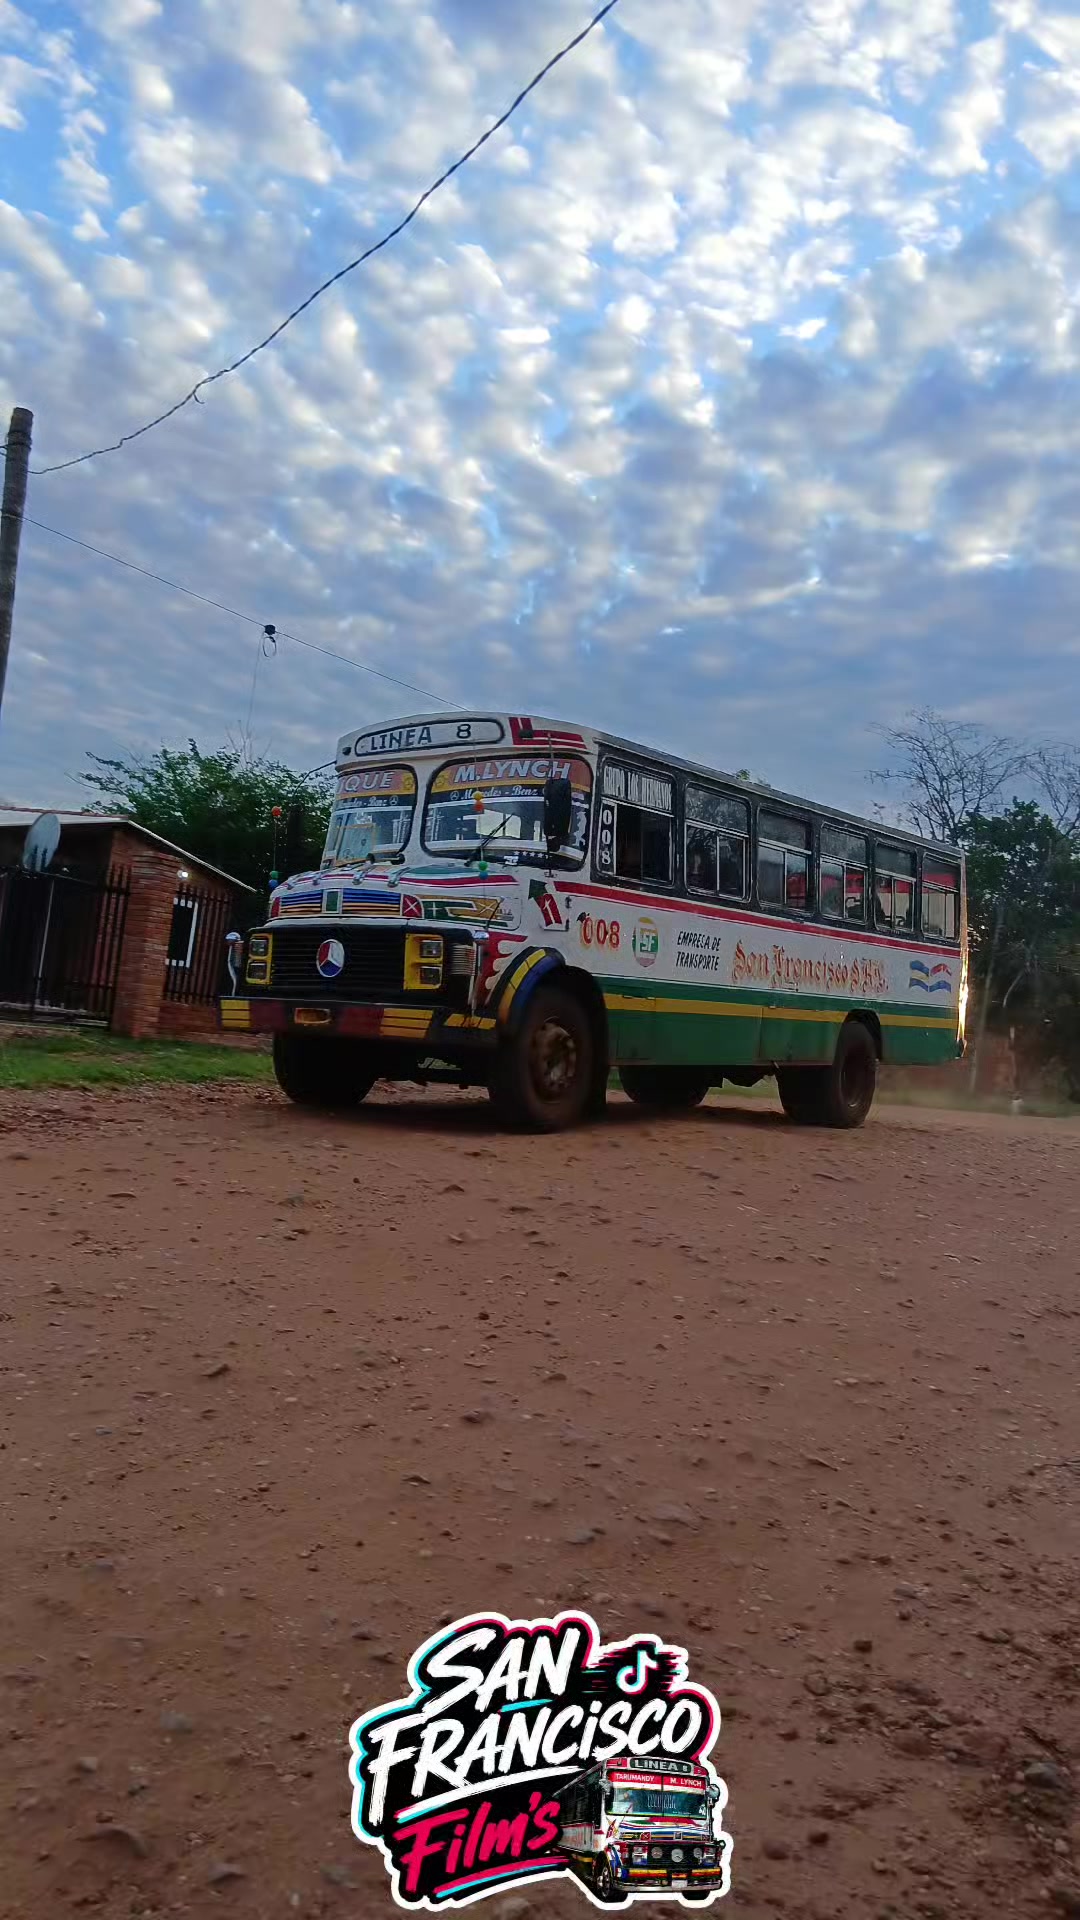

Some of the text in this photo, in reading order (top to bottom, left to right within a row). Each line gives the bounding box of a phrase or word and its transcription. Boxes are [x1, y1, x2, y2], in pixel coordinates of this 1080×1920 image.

[370, 723, 472, 751] LINEA 8
[511, 784, 539, 796] Benz
[603, 765, 625, 799] GRUPO
[627, 771, 639, 802] LOS
[601, 809, 613, 865] 008
[582, 916, 621, 949] 008
[676, 930, 710, 950] EMPRESA
[711, 937, 722, 951] DE
[675, 951, 720, 971] TRANSPORTE
[732, 939, 770, 982] San
[771, 944, 849, 992] Francisco
